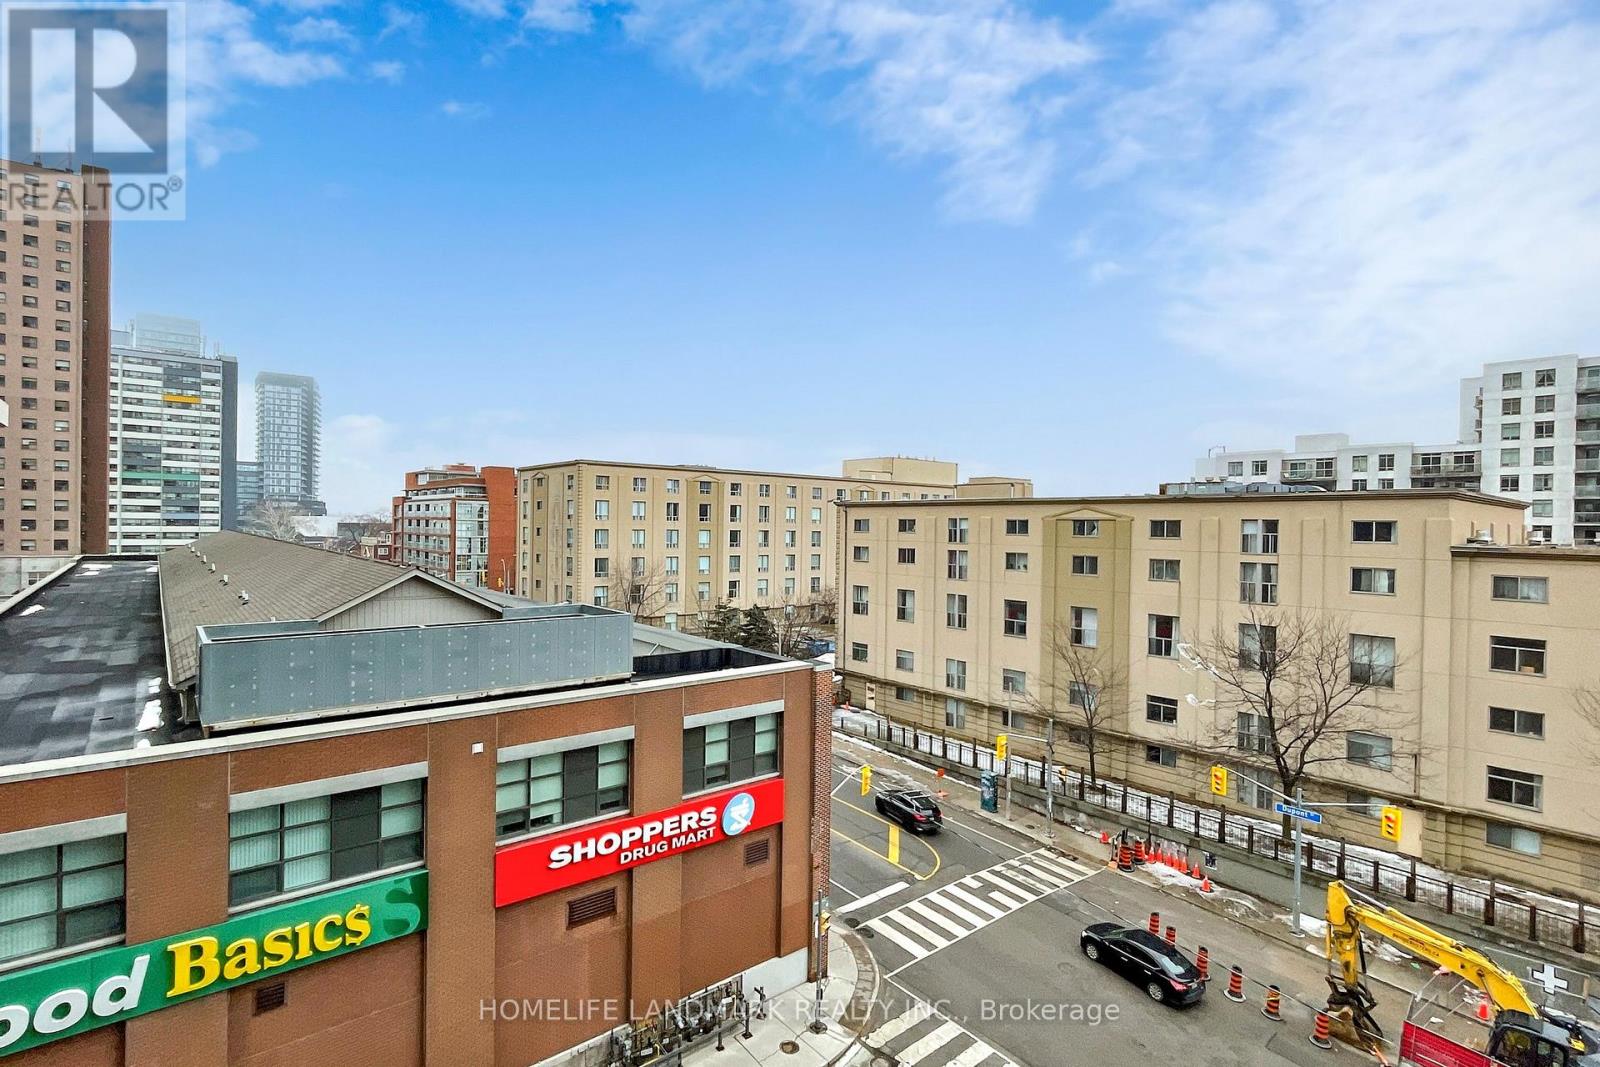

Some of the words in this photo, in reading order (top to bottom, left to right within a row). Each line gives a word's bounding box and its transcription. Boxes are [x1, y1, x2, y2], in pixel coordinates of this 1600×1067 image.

[1282, 804, 1308, 818] Dupont
[548, 806, 717, 869] SHOPPERS
[620, 840, 668, 865] DRUG
[671, 825, 716, 849] MART
